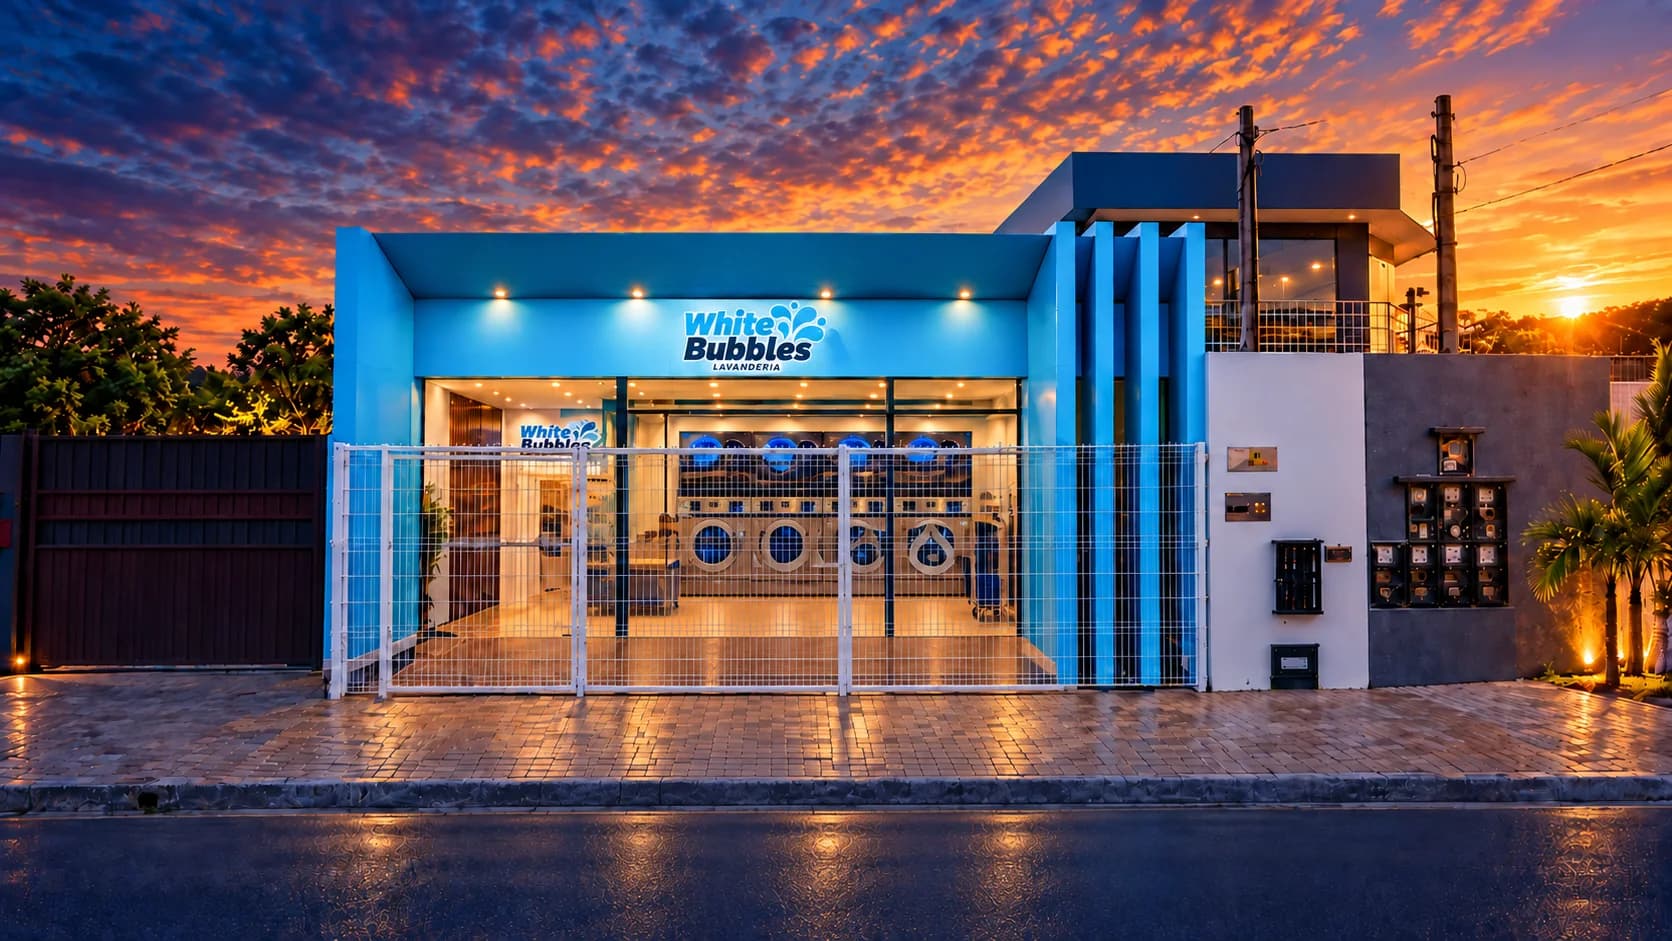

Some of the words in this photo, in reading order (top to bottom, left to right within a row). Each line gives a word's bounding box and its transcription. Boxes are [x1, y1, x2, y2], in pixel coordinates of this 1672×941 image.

[685, 309, 775, 336] White
[684, 336, 812, 361] Bubbles
[713, 363, 780, 371] LAVANDERIA
[520, 425, 571, 438] White
